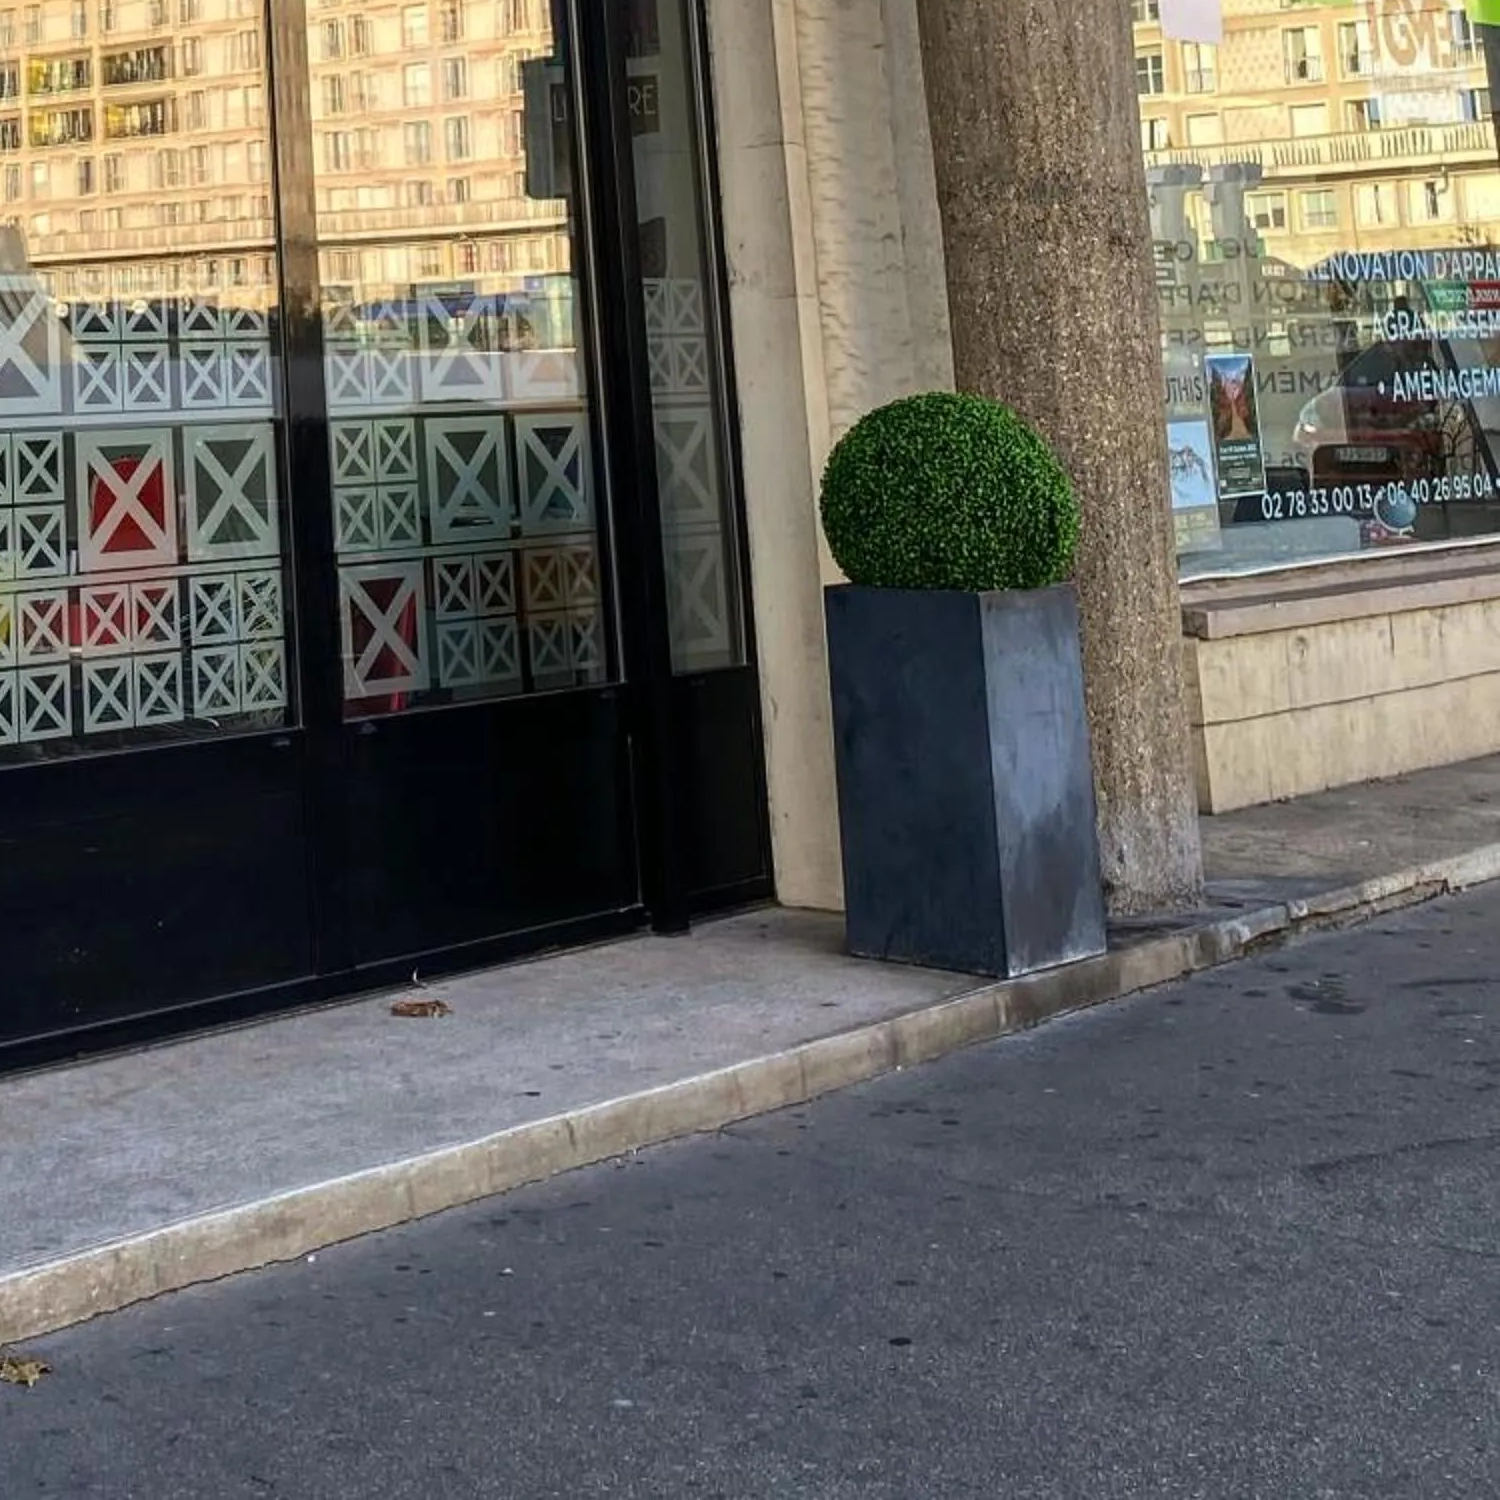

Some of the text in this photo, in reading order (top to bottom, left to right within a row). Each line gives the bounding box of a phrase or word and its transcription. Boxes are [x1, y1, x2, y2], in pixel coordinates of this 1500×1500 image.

[1261, 472, 1493, 519] 02 78 33 00 13 06 40 26 95 04
